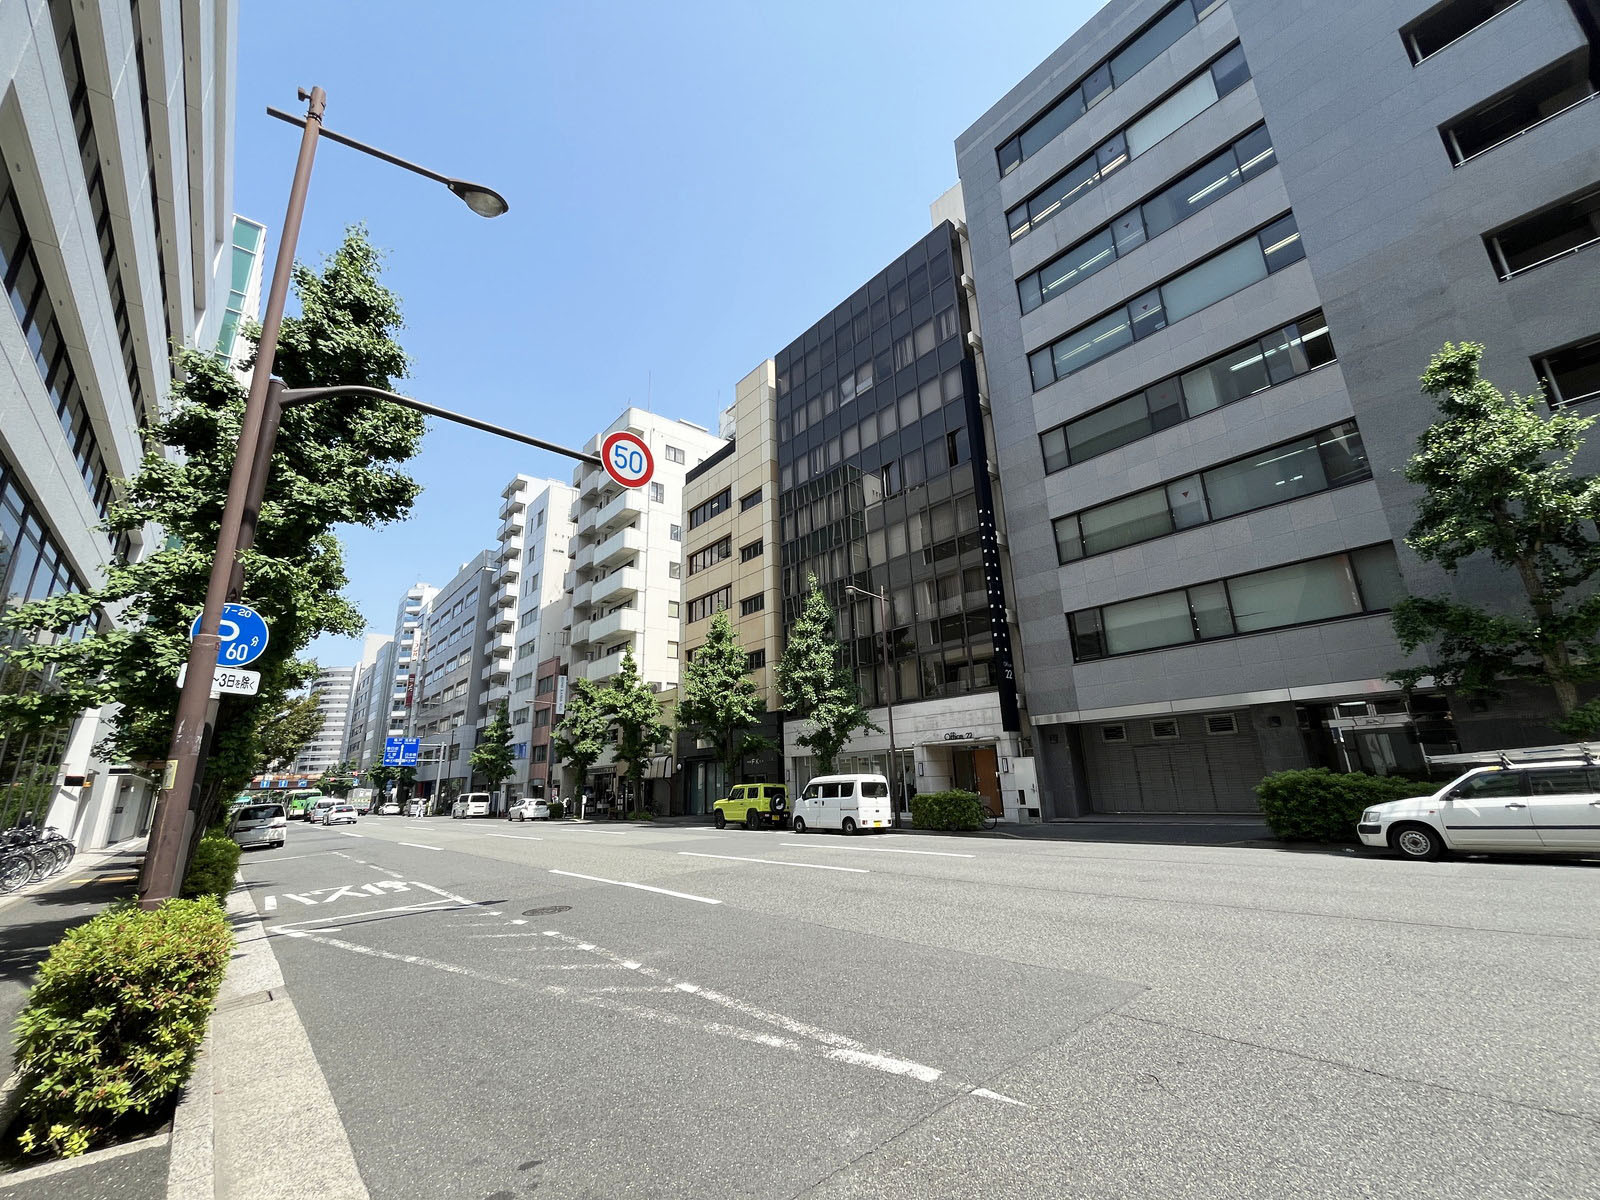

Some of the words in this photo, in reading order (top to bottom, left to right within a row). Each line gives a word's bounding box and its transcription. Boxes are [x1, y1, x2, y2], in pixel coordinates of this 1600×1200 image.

[614, 444, 643, 474] 50
[251, 636, 259, 647] 分
[226, 642, 248, 661] 60
[1004, 669, 1012, 679] 22
[264, 880, 411, 911] バス停
